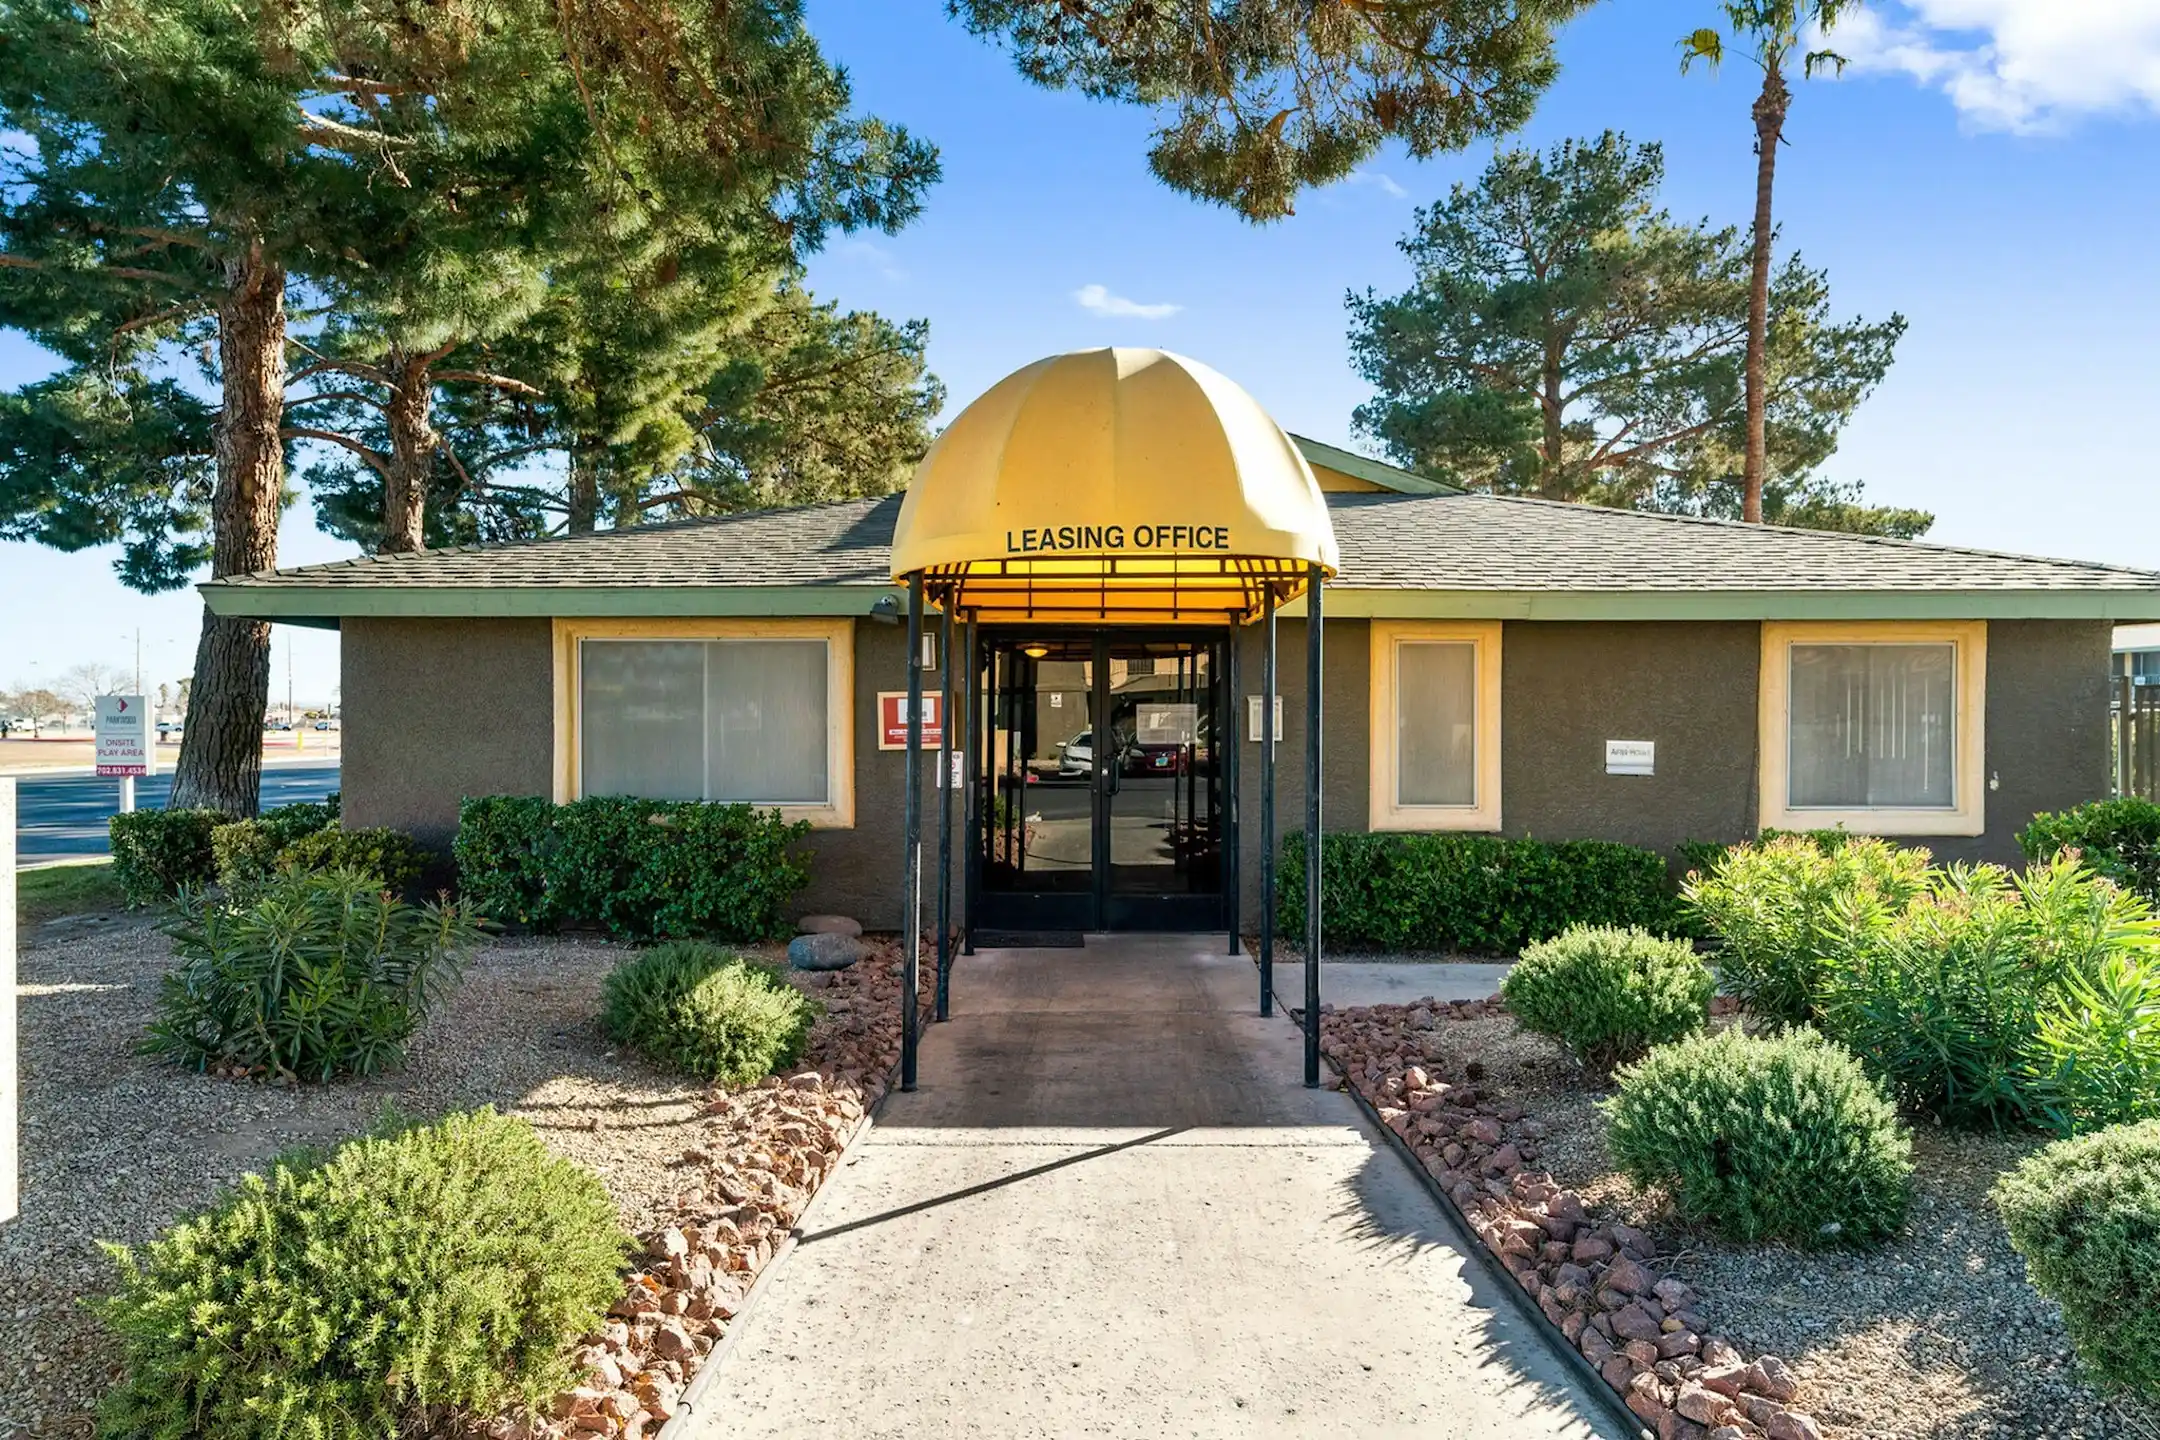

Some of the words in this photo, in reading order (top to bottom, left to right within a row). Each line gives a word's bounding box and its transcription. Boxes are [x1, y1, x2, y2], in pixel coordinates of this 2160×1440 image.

[1006, 525, 1124, 552] LEASING
[1133, 525, 1229, 549] OFFICE
[105, 738, 135, 747] ONSITE
[97, 749, 119, 757] PLAY
[120, 749, 144, 757] AREA
